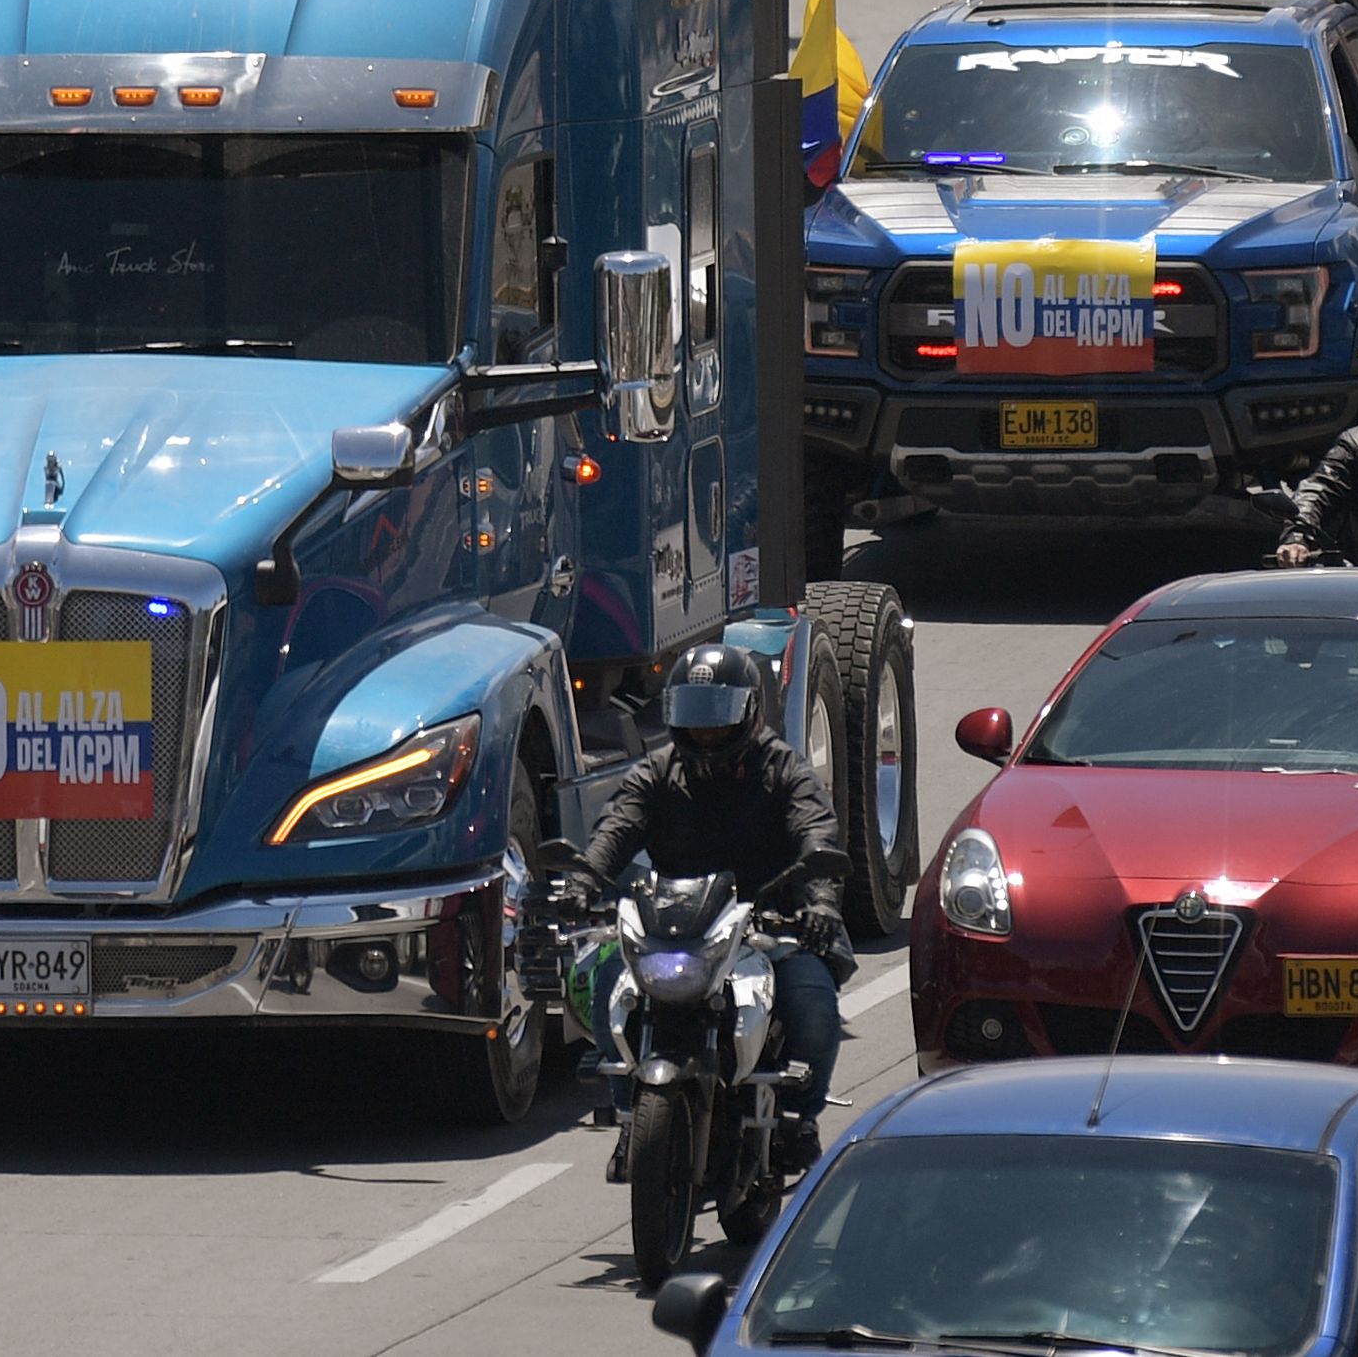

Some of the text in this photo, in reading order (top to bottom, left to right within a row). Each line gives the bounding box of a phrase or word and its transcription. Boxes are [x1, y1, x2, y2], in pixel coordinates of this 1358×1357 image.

[957, 42, 1243, 78] RAPTOR
[106, 246, 157, 275] Truck
[964, 262, 1035, 347] NO
[1043, 274, 1069, 306] AL
[1076, 273, 1131, 306] ALZA
[1043, 309, 1076, 337] DEL
[1077, 308, 1143, 347] ACPM
[15, 691, 48, 732] AL
[57, 691, 124, 732] ALZA
[16, 735, 140, 785] DEL ACPM
[13, 982, 50, 992] SOACHA
